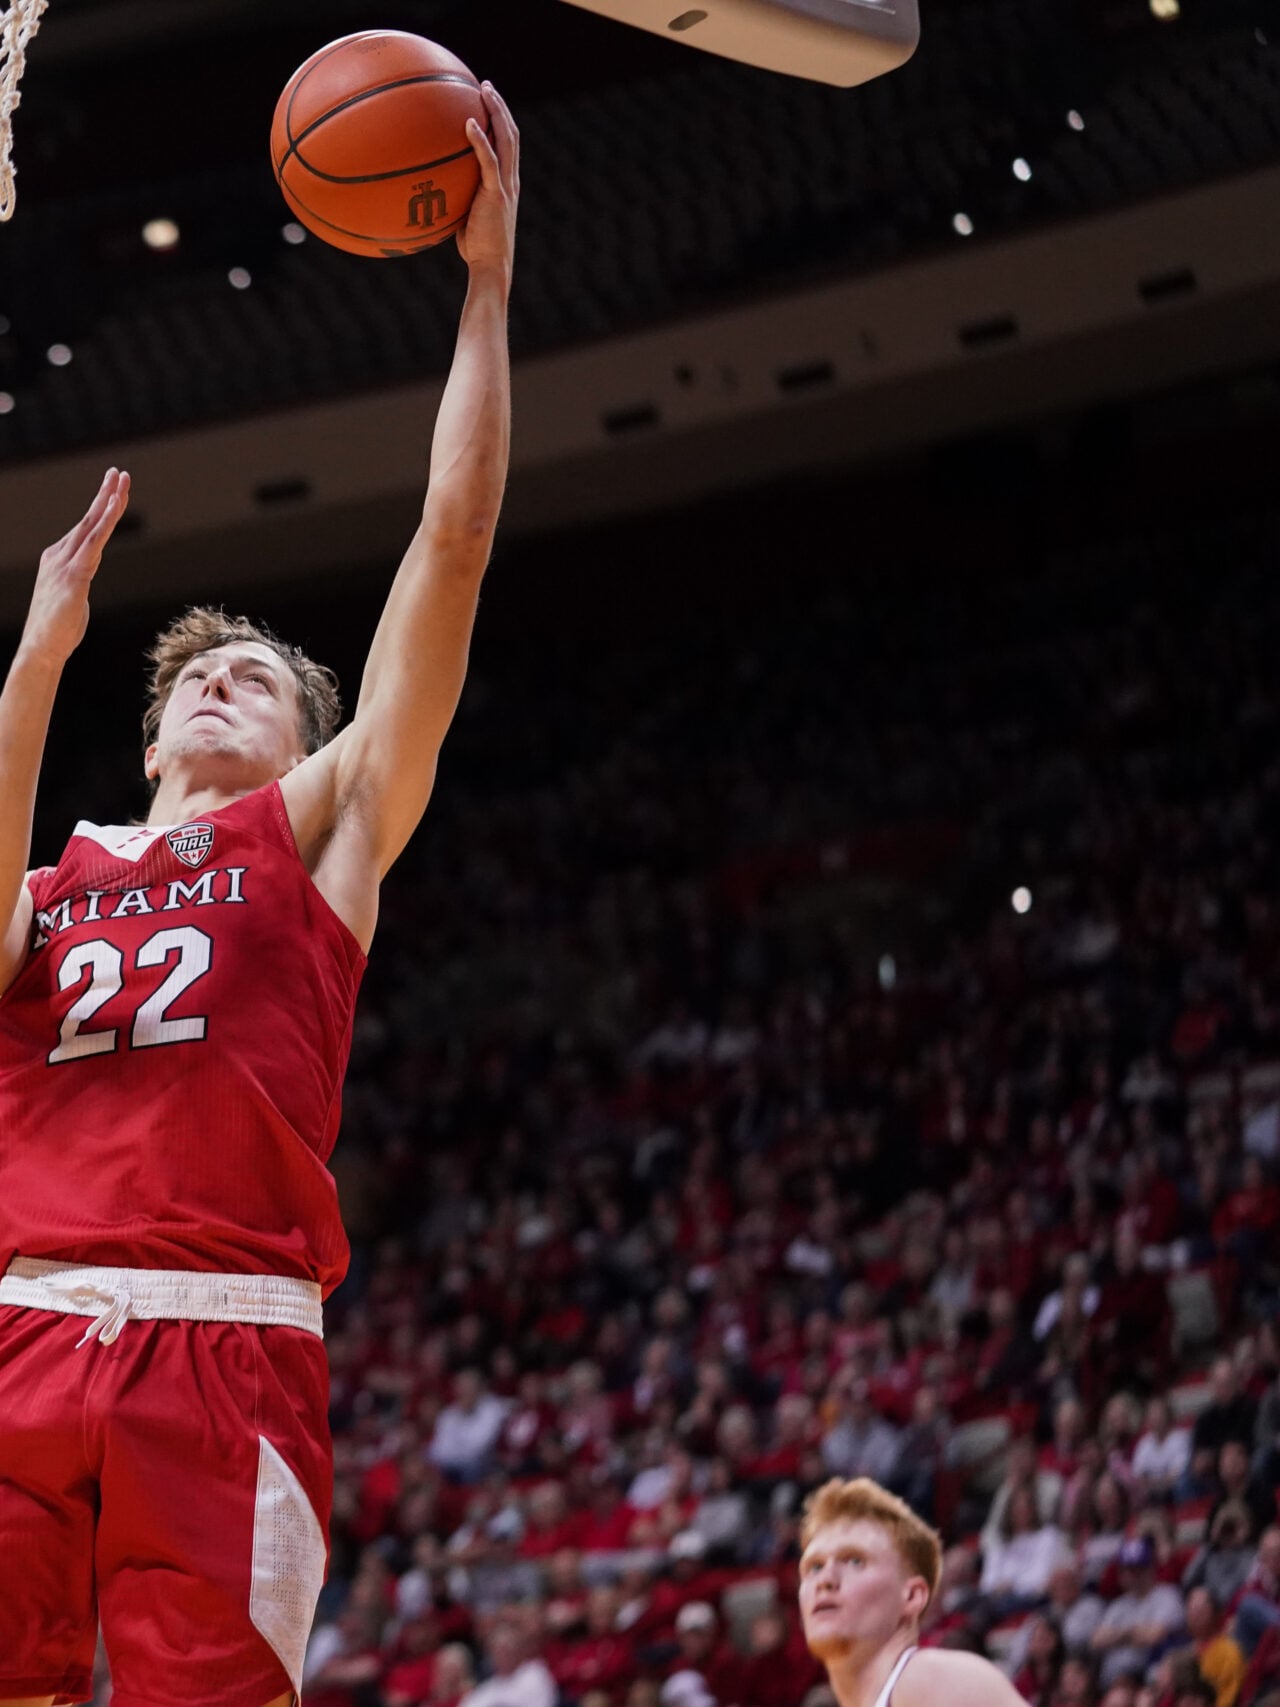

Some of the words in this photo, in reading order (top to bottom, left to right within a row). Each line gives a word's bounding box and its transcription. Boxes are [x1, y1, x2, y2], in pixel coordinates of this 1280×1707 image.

[172, 834, 212, 852] MAC
[33, 868, 250, 949] MIAMI
[46, 925, 215, 1067] 22
